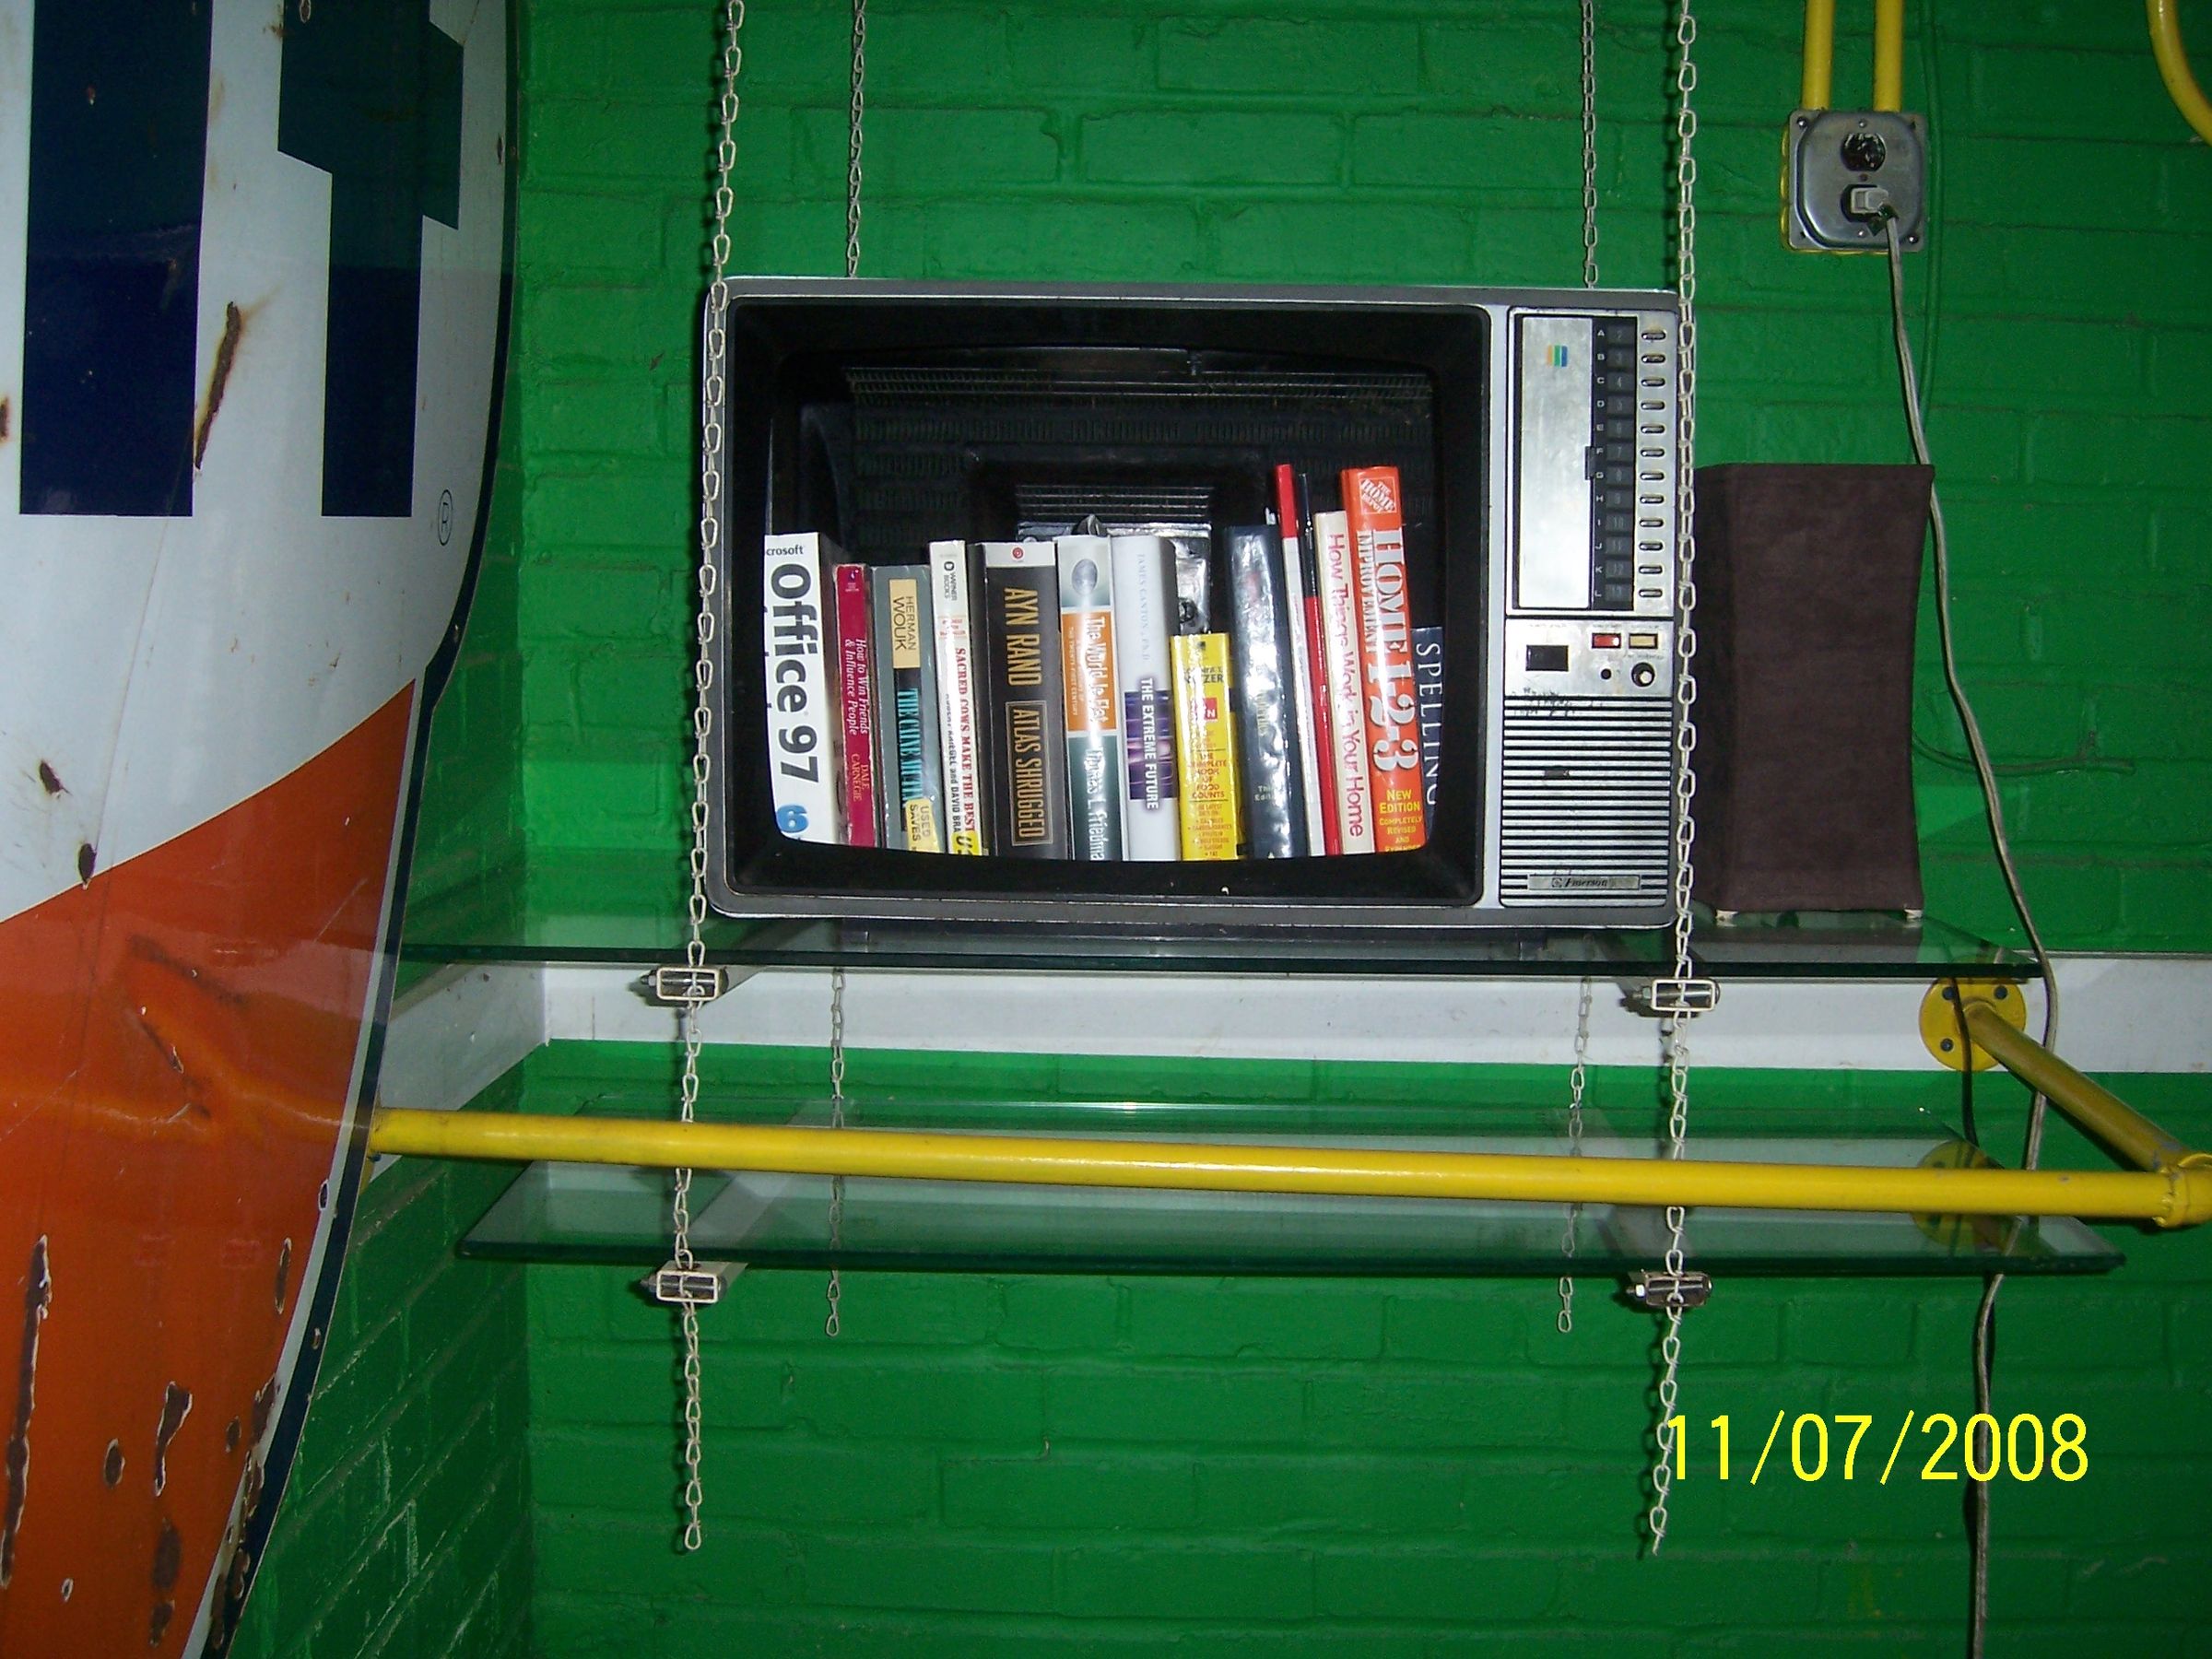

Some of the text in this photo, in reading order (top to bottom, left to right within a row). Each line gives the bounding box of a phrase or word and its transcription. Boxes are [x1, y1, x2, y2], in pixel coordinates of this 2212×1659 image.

[1596, 376, 1605, 384] C
[1596, 447, 1604, 455] F
[1360, 478, 1395, 512] HOME
[766, 544, 804, 556] crosoft
[1328, 534, 1346, 580] How
[1594, 542, 1603, 550] J
[1357, 530, 1381, 653] IMPROVEMENT
[893, 596, 907, 651] WOUK
[906, 595, 916, 651] HERMAN
[1004, 587, 1042, 686] AYN RAND
[1087, 616, 1106, 640] The
[1086, 642, 1109, 678] World
[1368, 526, 1418, 771] HOME 1-2-3
[771, 563, 819, 783] Office 97
[845, 650, 856, 699] Influence
[855, 639, 870, 735] How to Win Friends
[845, 700, 858, 736] People
[898, 688, 919, 716] THE
[956, 648, 975, 832] SACRED COWS MAKE THE BEST
[1141, 678, 1159, 809] THE EXTREME FUTURE
[1343, 730, 1360, 772] Your
[851, 752, 862, 802] CARNEGIE
[860, 764, 870, 790] DALE
[1013, 709, 1045, 838] ATLAS SHRUGGED
[951, 786, 960, 813] DAVID
[1192, 791, 1225, 799] COUNTS
[1346, 776, 1365, 837] Home
[1379, 801, 1420, 814] EDITION
[1386, 789, 1411, 801] NEW
[910, 804, 922, 841] SAVES
[921, 806, 931, 837] USED
[953, 816, 963, 833] BRA
[1088, 810, 1109, 861] Friedma
[1379, 816, 1422, 826] COMPLETELY
[1386, 826, 1417, 835] REVISED
